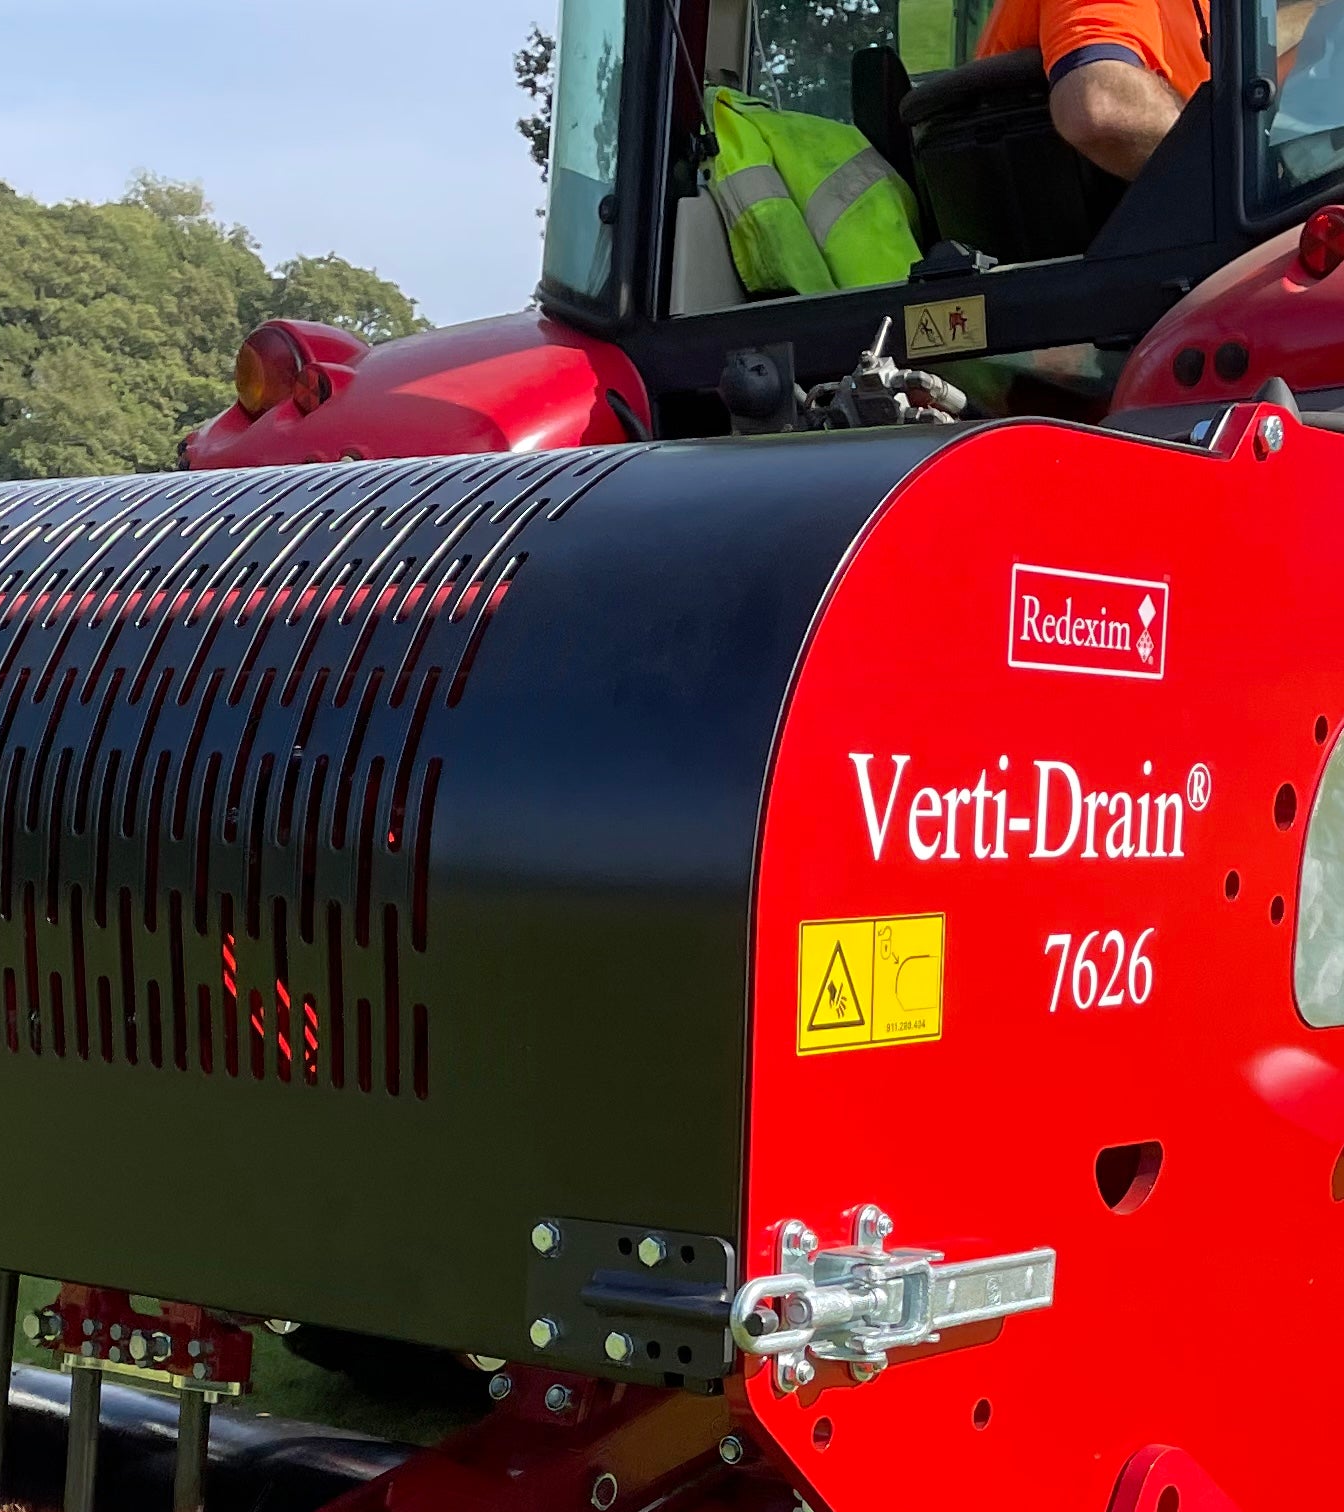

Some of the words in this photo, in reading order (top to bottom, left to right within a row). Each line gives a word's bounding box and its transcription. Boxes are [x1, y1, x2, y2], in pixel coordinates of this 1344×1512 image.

[1019, 594, 1132, 652] Redexim
[848, 752, 1212, 862] Verti-Drain®
[1043, 926, 1156, 1014] 7626
